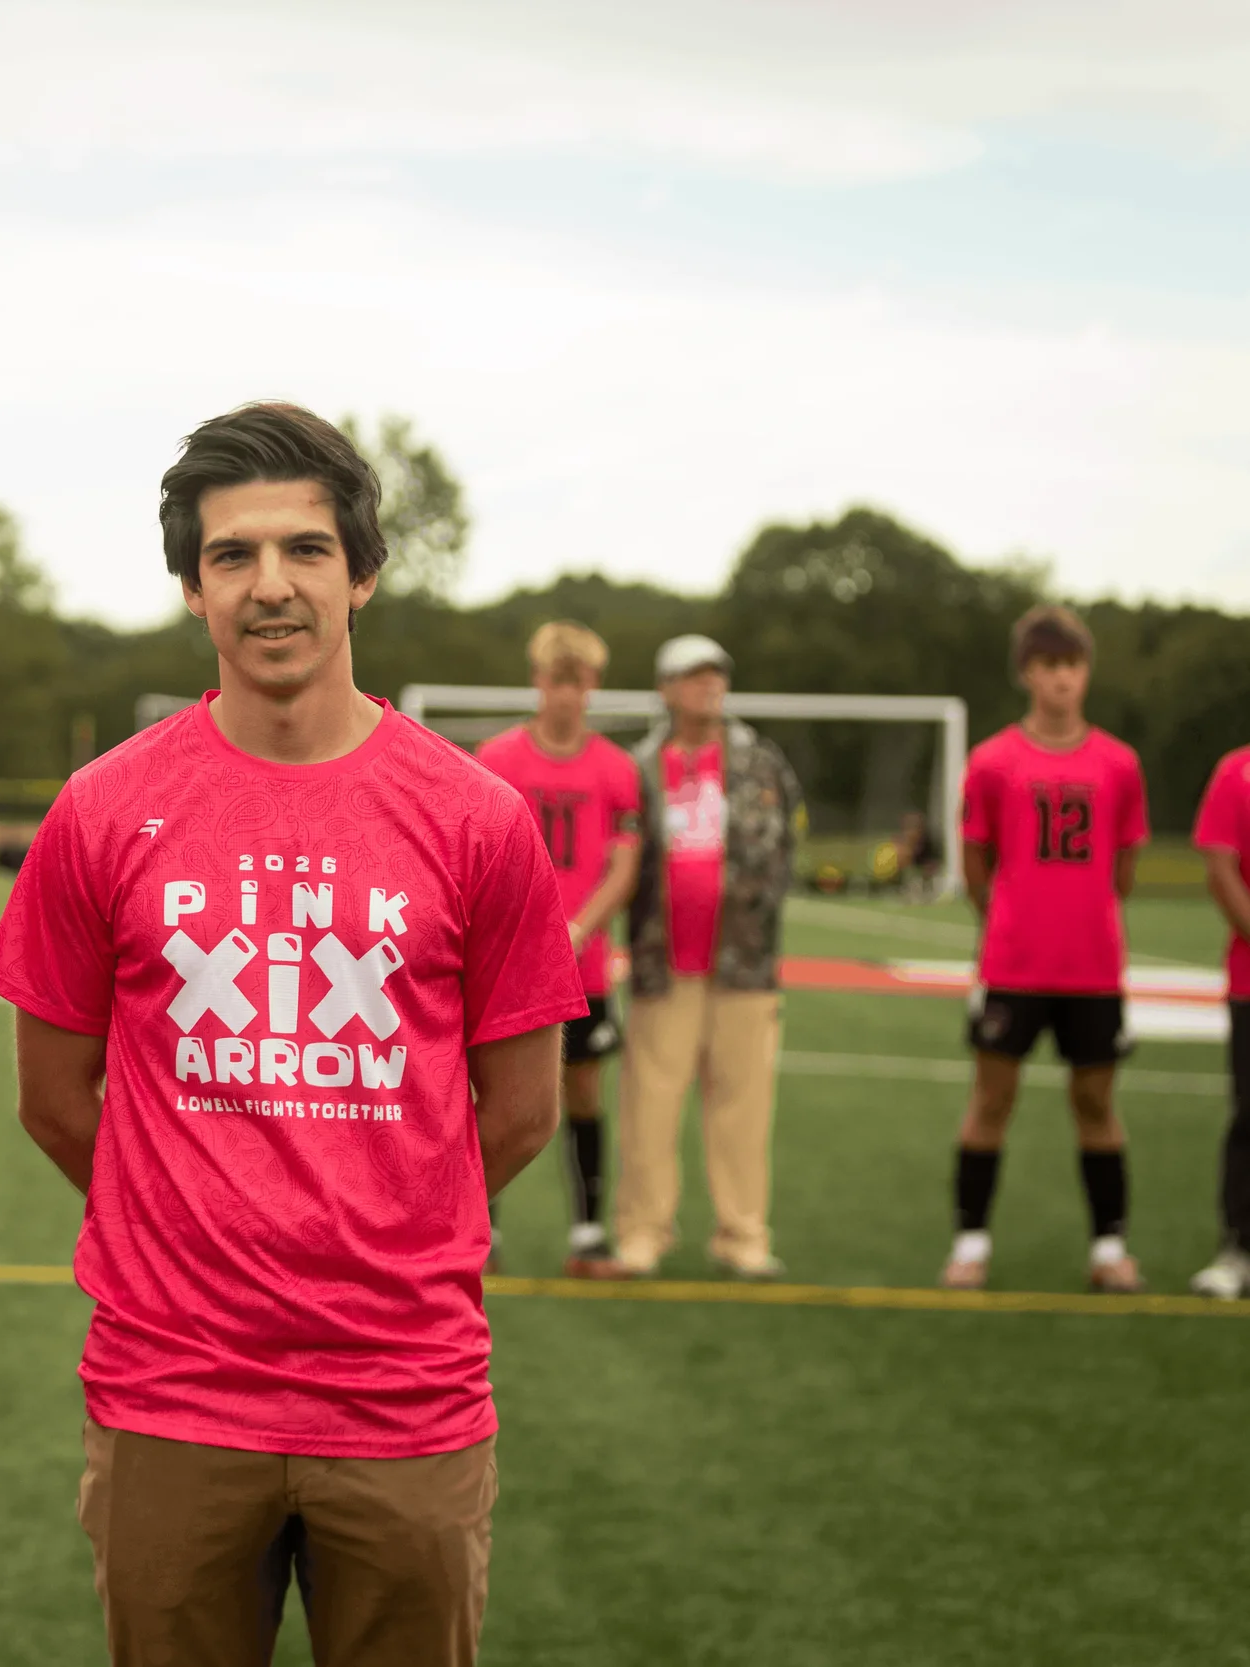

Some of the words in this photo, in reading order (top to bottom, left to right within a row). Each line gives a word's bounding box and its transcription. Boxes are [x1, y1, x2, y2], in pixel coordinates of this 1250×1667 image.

[1036, 795, 1092, 861] 12
[238, 854, 337, 874] 2026
[175, 1037, 407, 1089] ARROW
[176, 1095, 243, 1113] LOWELL
[309, 1102, 402, 1121] TOGETHER
